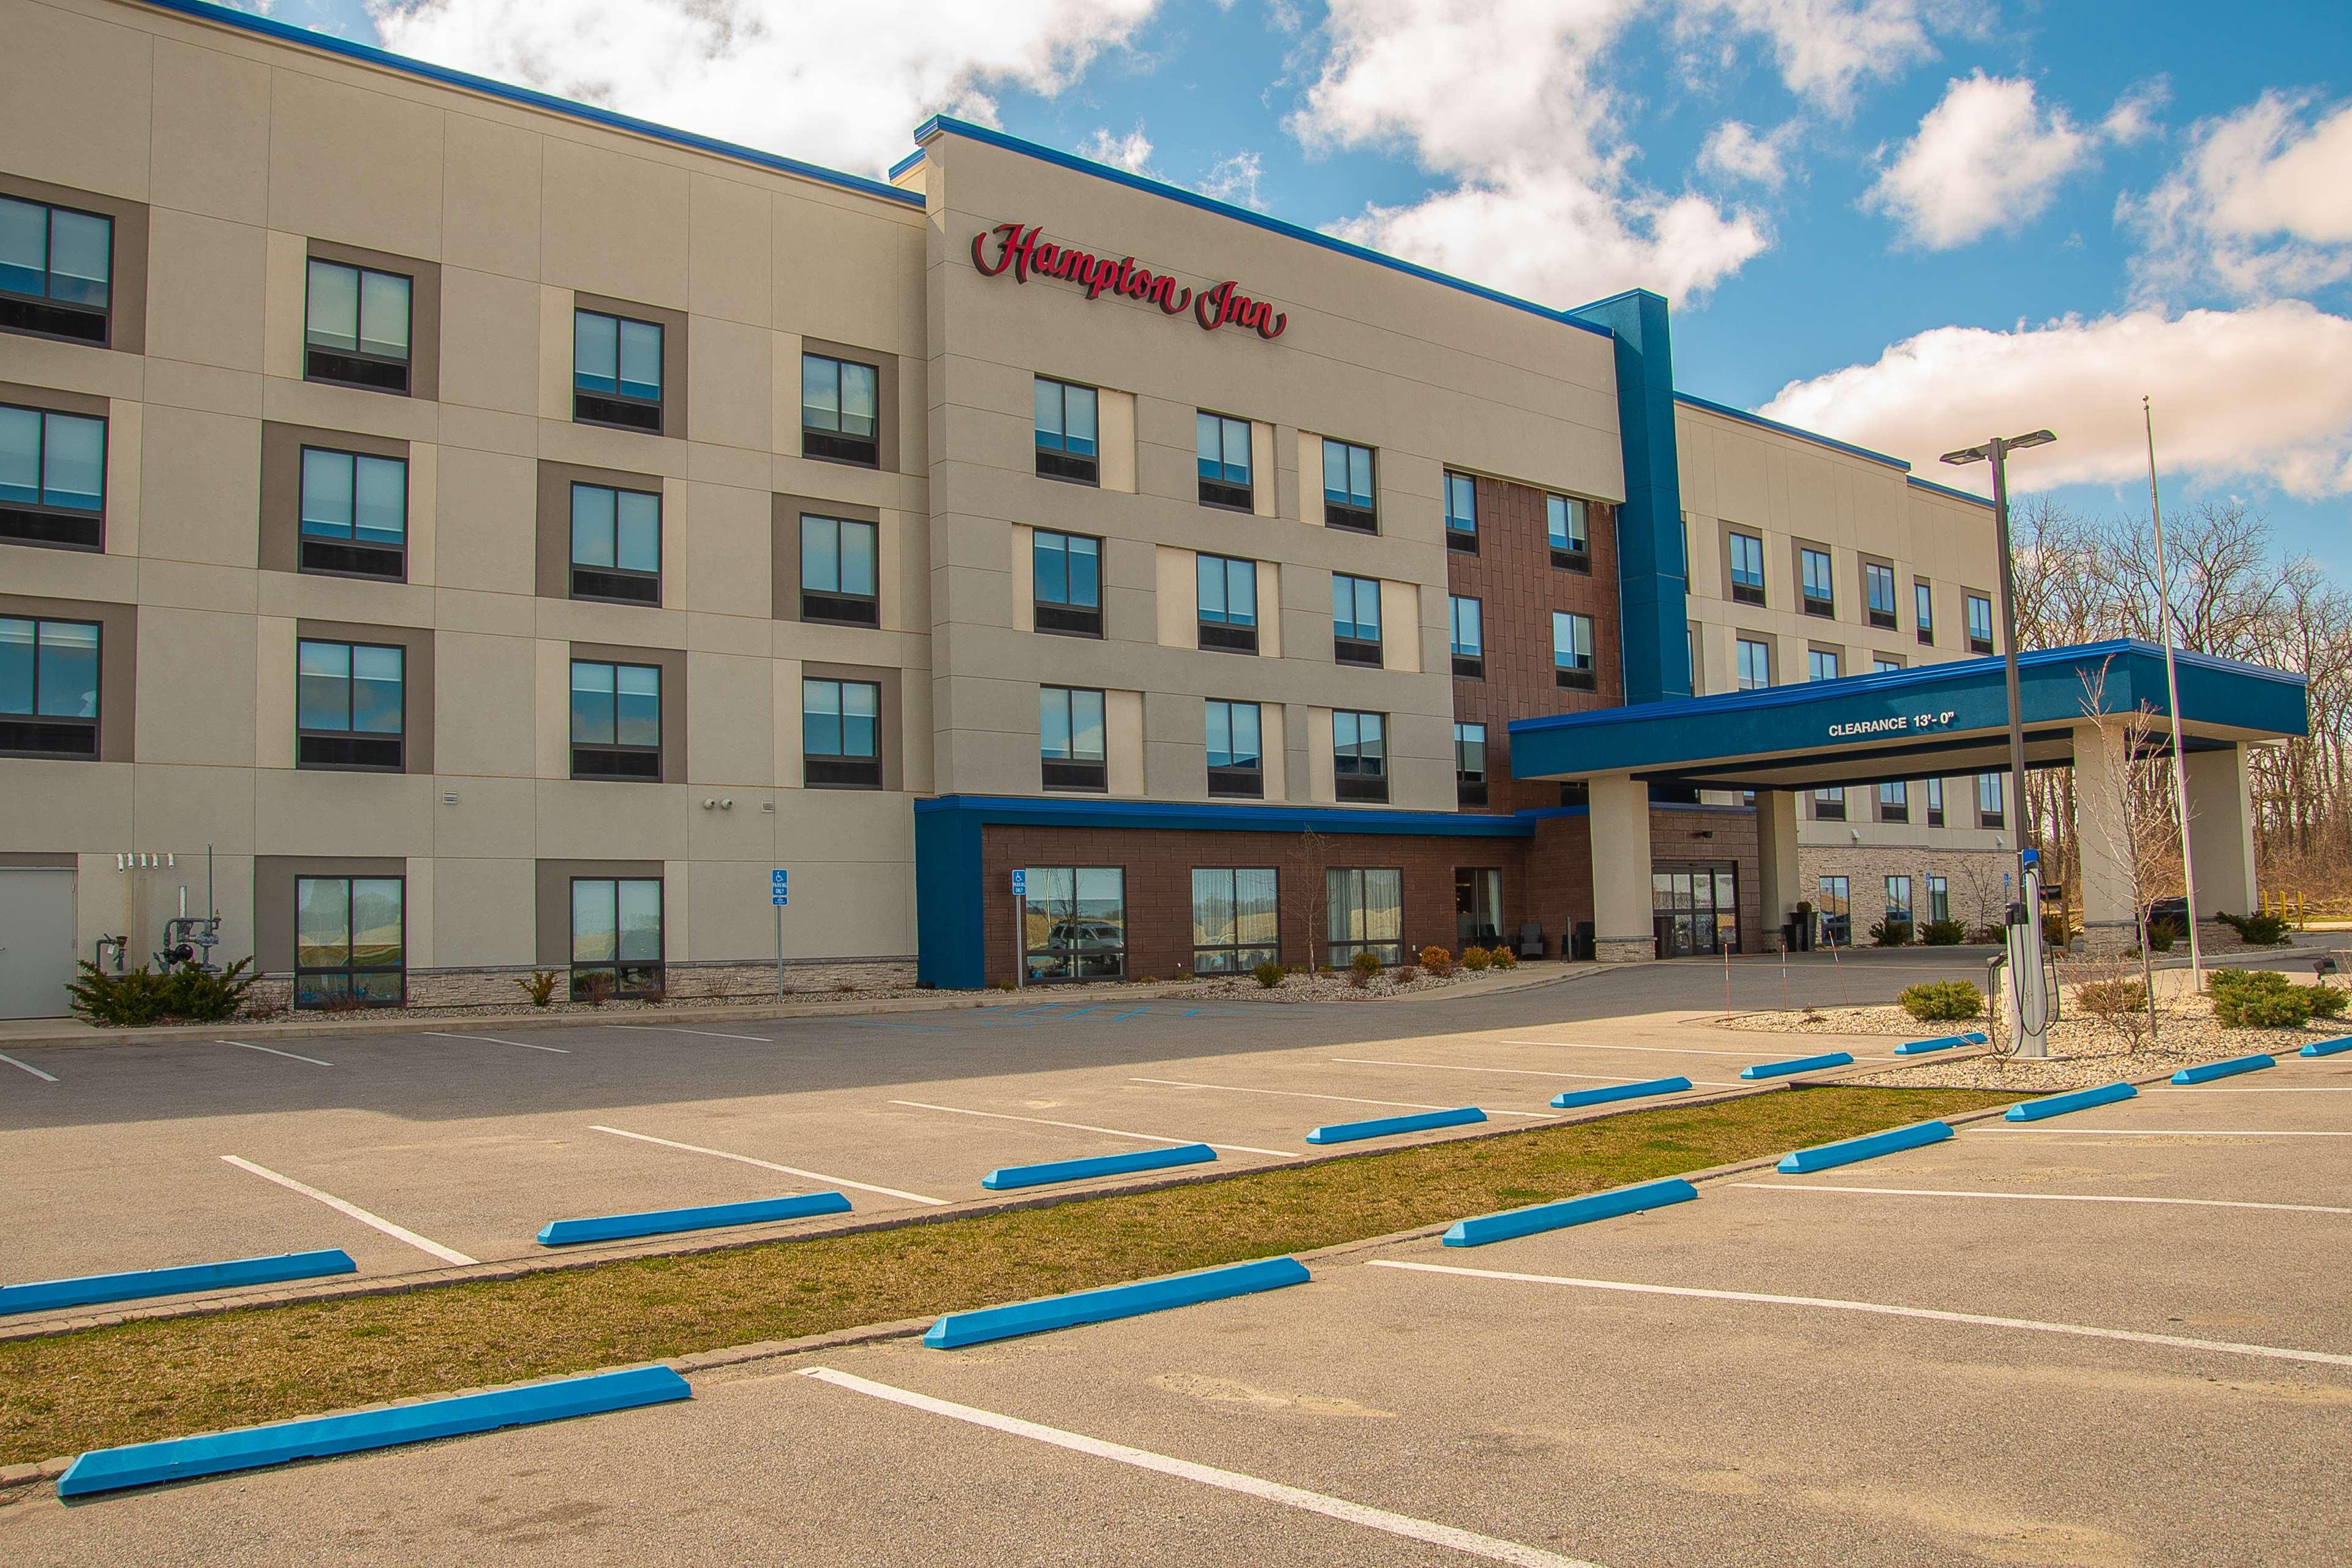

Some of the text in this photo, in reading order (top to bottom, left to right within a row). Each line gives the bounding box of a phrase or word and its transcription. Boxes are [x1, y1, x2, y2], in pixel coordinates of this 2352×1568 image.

[971, 223, 1287, 339] Hampton Inn
[1828, 717, 1907, 737] CLEARANCE
